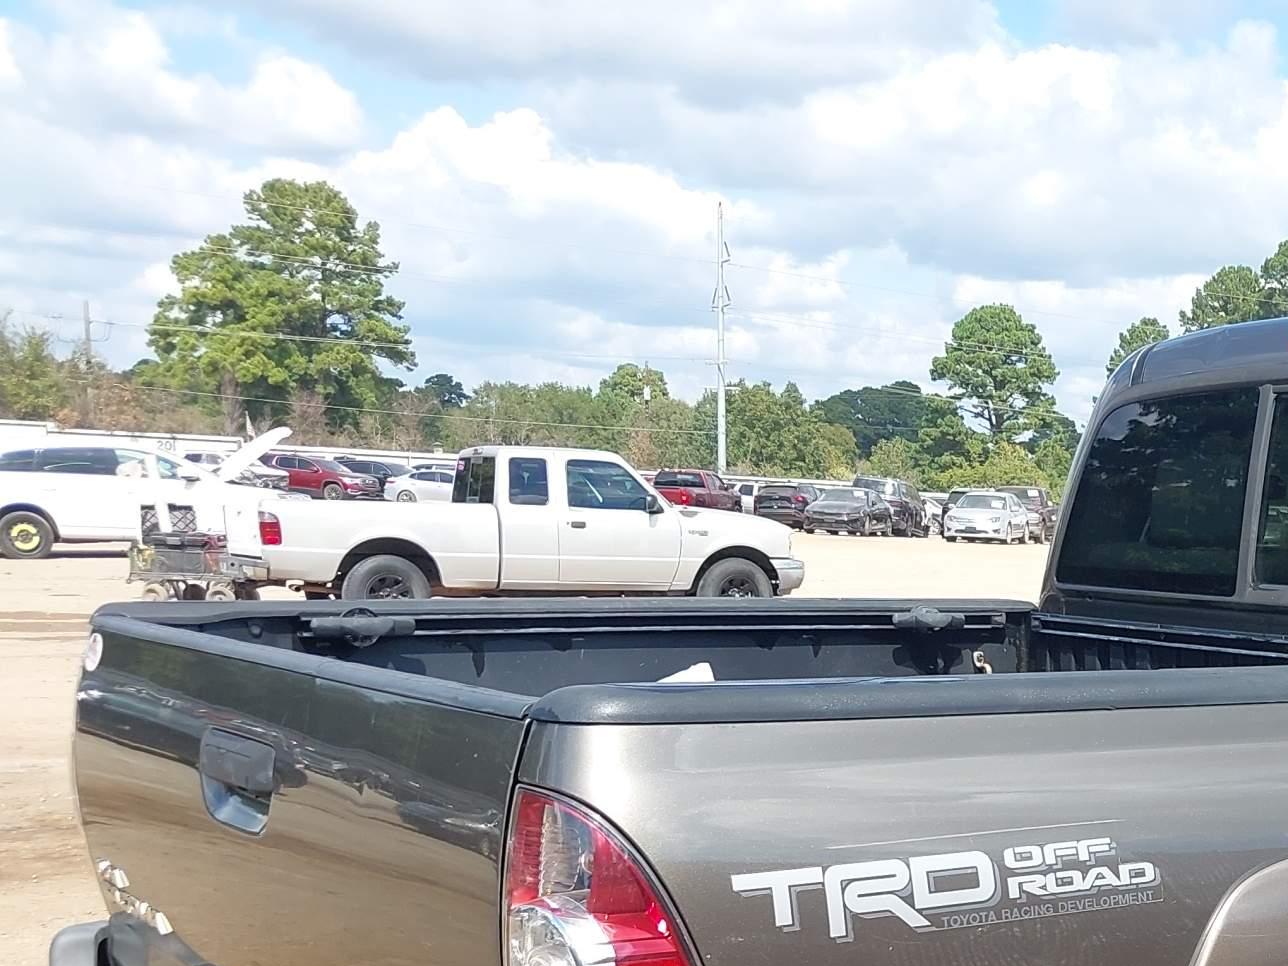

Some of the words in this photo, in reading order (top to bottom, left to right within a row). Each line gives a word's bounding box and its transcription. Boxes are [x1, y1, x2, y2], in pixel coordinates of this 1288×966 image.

[1002, 836, 1117, 869] OFF
[729, 850, 1000, 942] TRD
[1008, 861, 1161, 901] ROAD
[941, 910, 997, 929] TOYOTA
[1002, 903, 1054, 921] RACING
[1058, 890, 1154, 914] DEVELOPMENT
